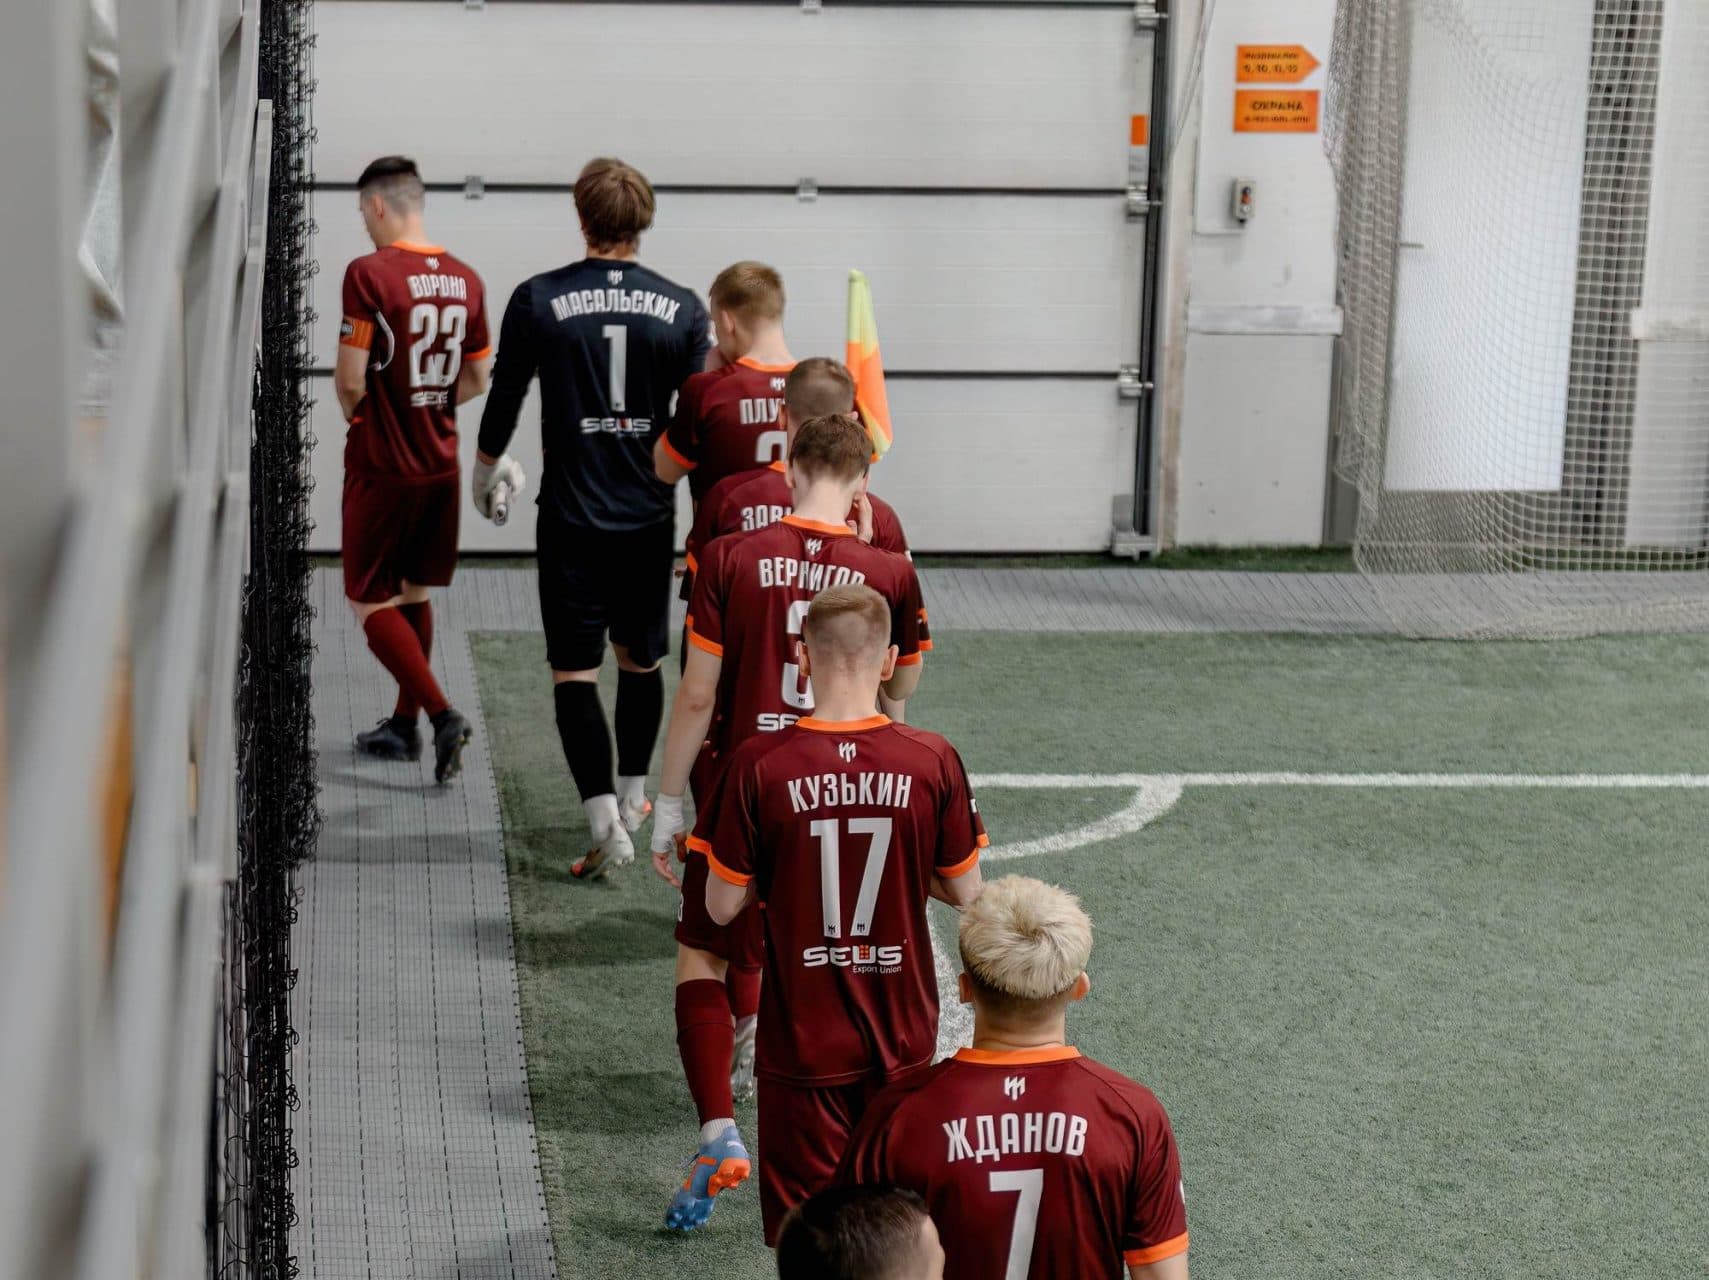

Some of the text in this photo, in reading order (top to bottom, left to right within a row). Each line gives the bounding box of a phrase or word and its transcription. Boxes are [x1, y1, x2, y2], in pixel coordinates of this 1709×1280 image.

[407, 274, 467, 300] ВОРОНА
[550, 288, 681, 324] МАСАЛЬСКИХ
[409, 303, 468, 388] 23
[602, 324, 628, 412] 1
[581, 417, 652, 434] SEUS
[739, 398, 786, 425] ПЛУ
[741, 504, 793, 532] ЗАВ
[757, 713, 800, 731] SE
[787, 772, 912, 813] КУЗЬКИН
[810, 817, 893, 939] 17
[803, 944, 903, 967] SEUS
[852, 965, 902, 974] Export Union
[942, 1112, 1088, 1164] ЖДАНОВ
